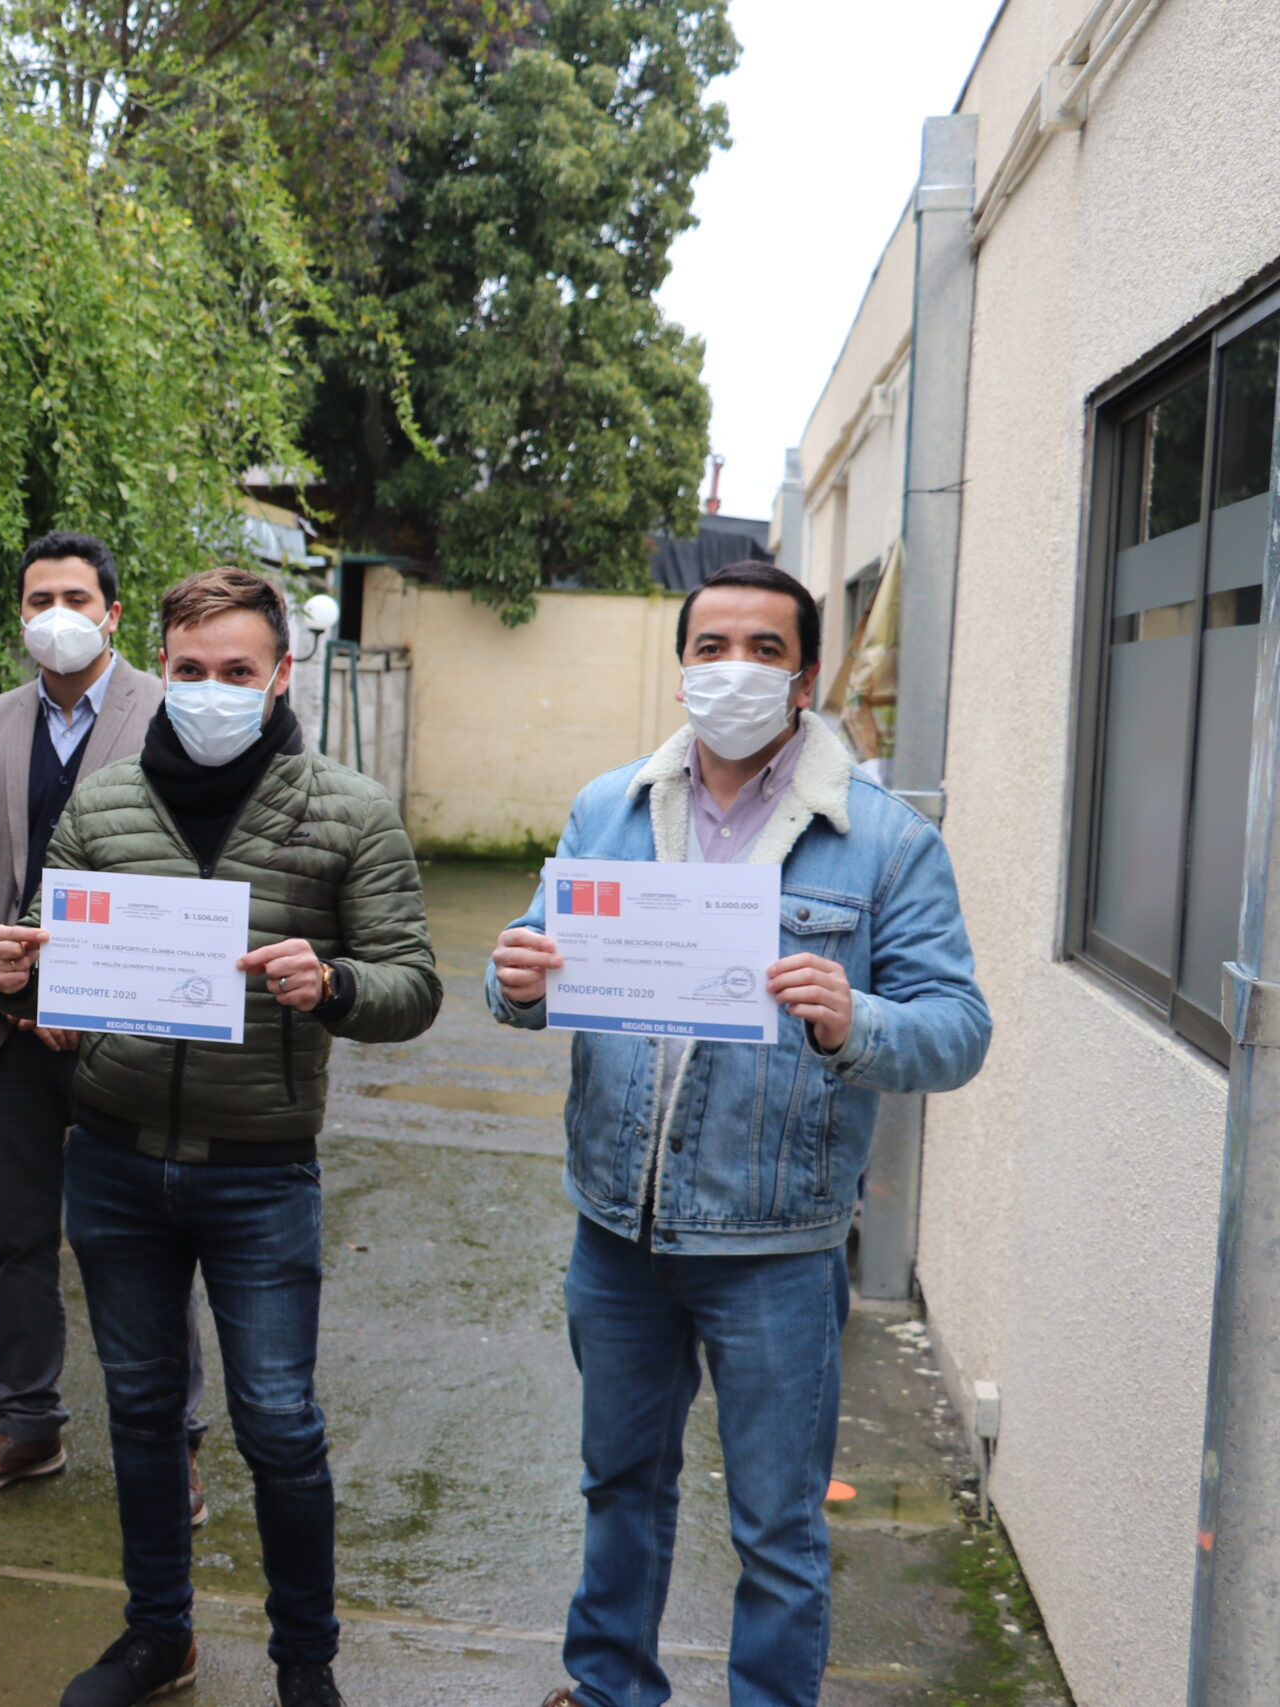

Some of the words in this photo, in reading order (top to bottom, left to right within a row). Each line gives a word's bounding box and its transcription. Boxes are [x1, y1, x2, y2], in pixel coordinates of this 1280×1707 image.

[714, 901, 759, 910] 5.000.000
[192, 913, 229, 922] 1.506.000
[624, 939, 663, 948] BICICROSS
[112, 944, 150, 953] DEPORTIVO
[151, 946, 175, 955] ZUMBA
[207, 951, 226, 960] VIEJO
[49, 984, 110, 998] FONDEPORTE
[112, 989, 137, 1001] 2020
[557, 983, 624, 997] FONDEPORTE
[627, 987, 655, 999] 2020
[106, 1020, 134, 1030] REGIÓN
[135, 1022, 145, 1031] DE
[147, 1022, 171, 1033] ÑUBLE
[622, 1021, 653, 1032] REGIÓN
[654, 1023, 665, 1032] DE
[667, 1022, 695, 1034] ÑUBLE
